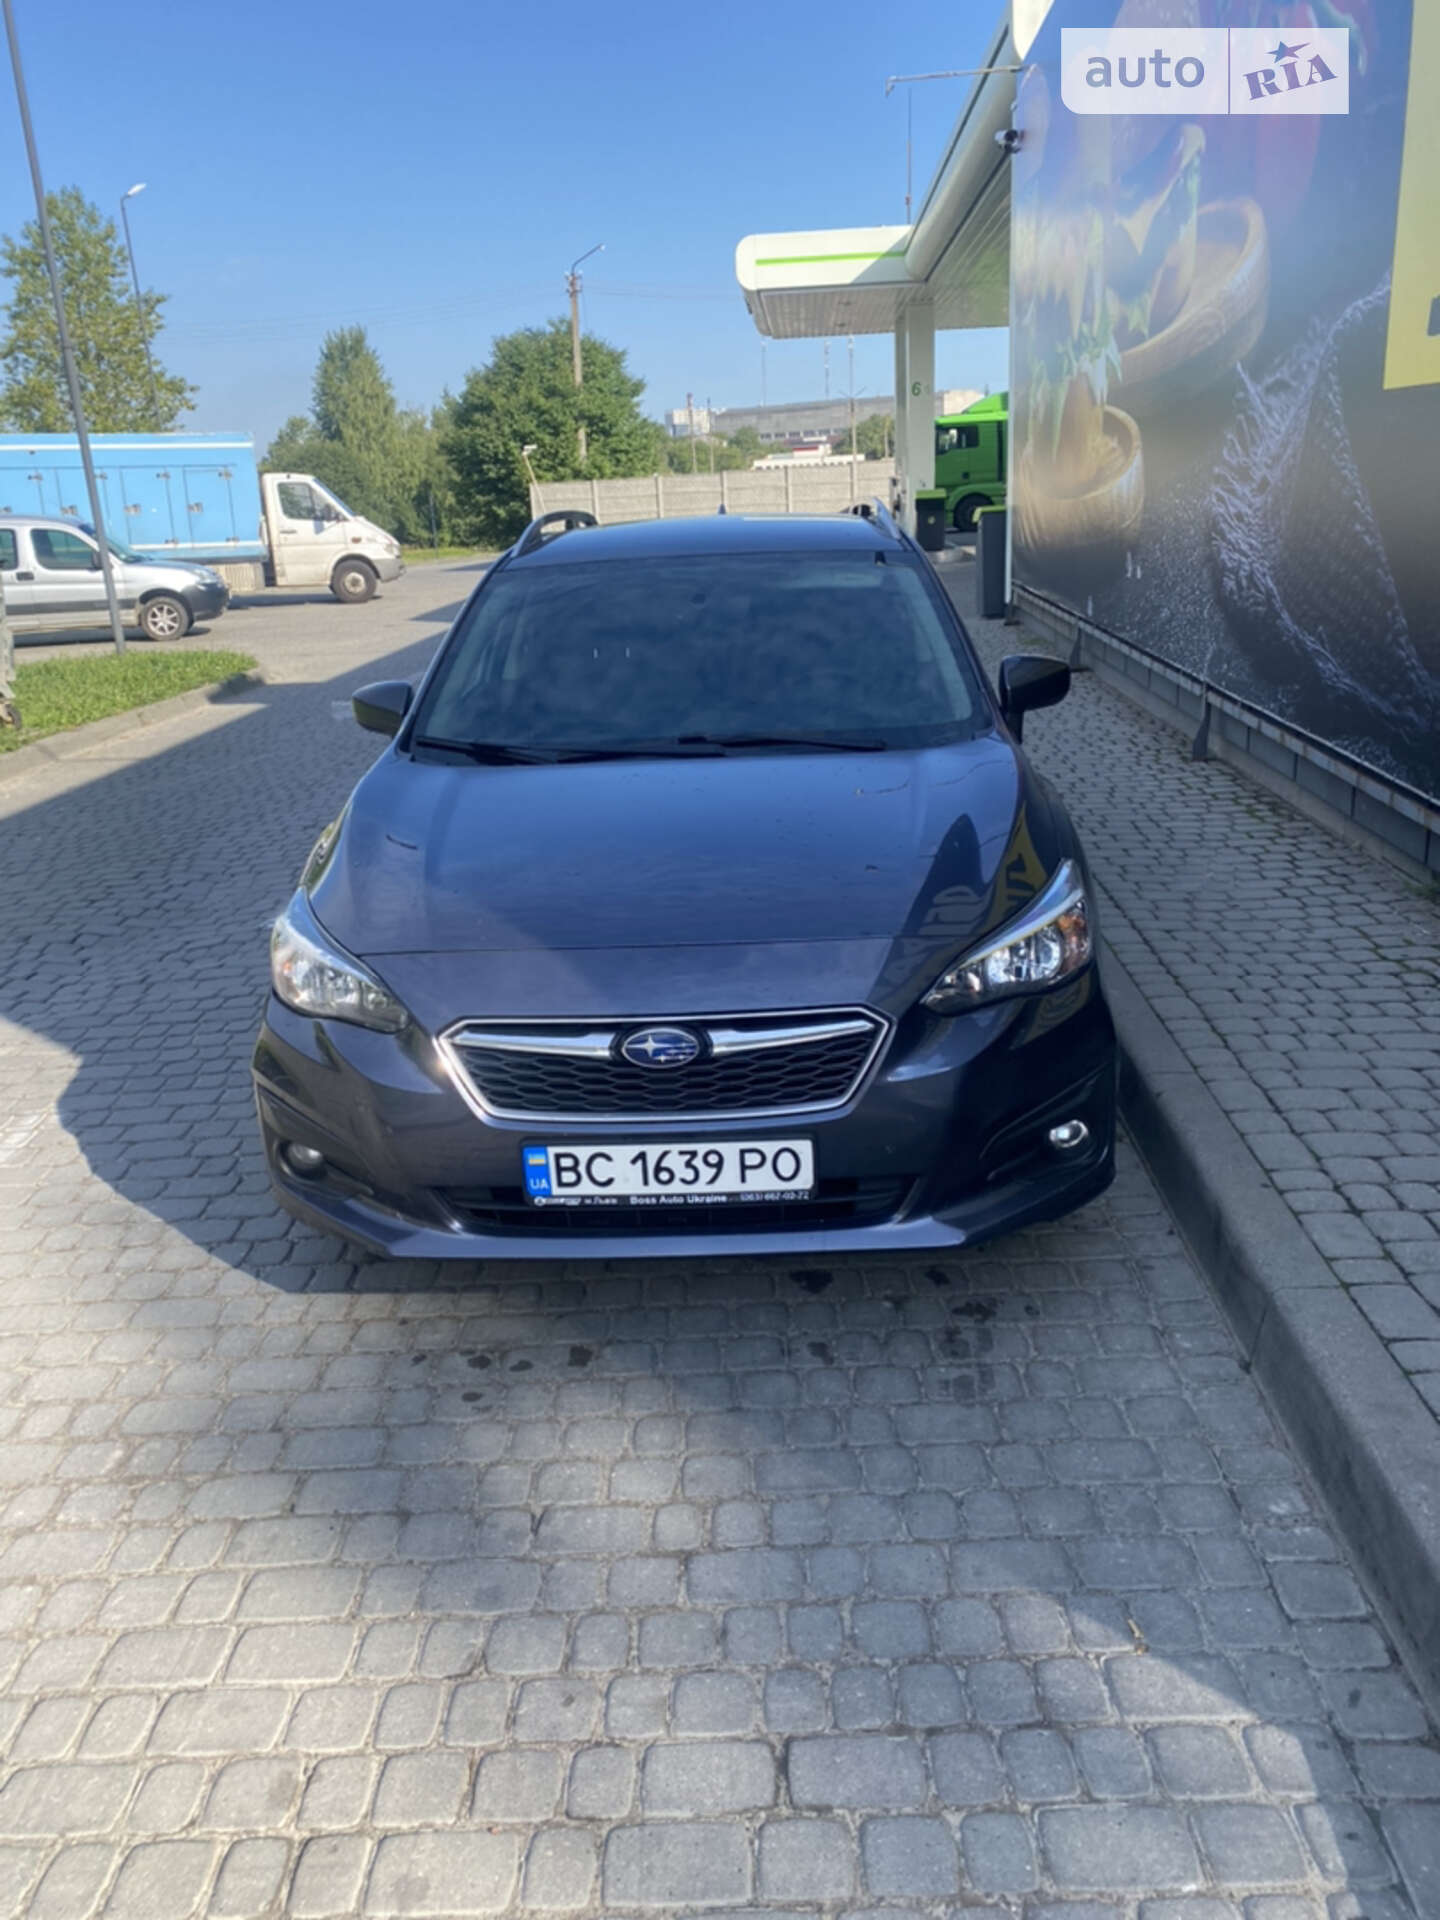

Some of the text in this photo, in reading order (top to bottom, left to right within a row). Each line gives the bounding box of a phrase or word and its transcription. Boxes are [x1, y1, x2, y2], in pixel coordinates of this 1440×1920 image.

[911, 381, 922, 397] 6
[554, 1147, 801, 1188] BC 1639 PO
[530, 1178, 549, 1190] UA
[629, 1194, 728, 1205] Boss Auto Ukraine
